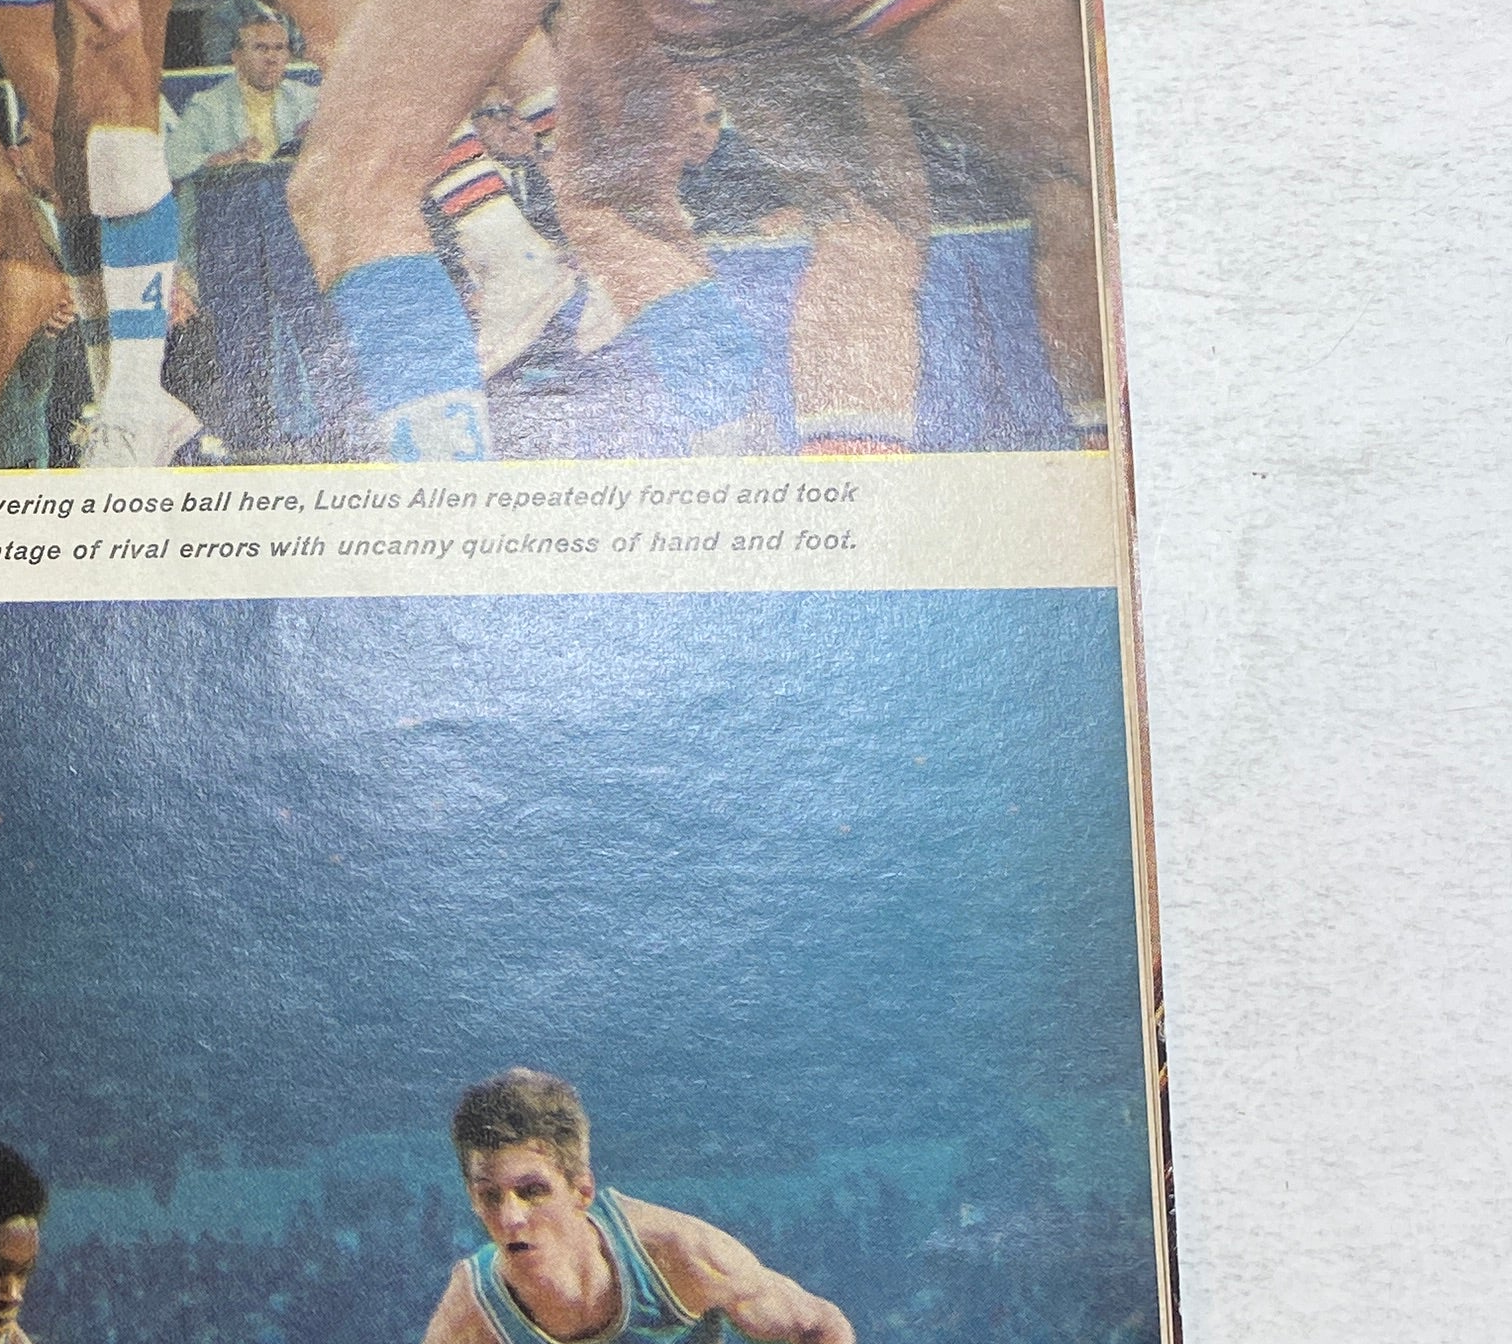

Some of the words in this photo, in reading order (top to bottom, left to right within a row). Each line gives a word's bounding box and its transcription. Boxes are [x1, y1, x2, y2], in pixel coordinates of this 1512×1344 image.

[81, 499, 95, 513] a
[103, 494, 174, 513] loose
[181, 491, 232, 512] ball
[238, 491, 305, 514] here,
[314, 489, 401, 510] Lucius
[407, 488, 477, 508] Allen
[485, 485, 631, 512] repeatedly
[640, 484, 730, 505] forced
[737, 483, 790, 504] and
[796, 481, 859, 503] took
[73, 540, 103, 559] of
[109, 539, 169, 559] rival
[180, 542, 261, 558] errors
[270, 536, 325, 557] with
[338, 539, 454, 560] uncanny
[462, 533, 600, 559] quickness
[612, 532, 643, 552] of
[649, 531, 720, 552] hand
[731, 530, 784, 551] and
[795, 529, 857, 551] foot.
